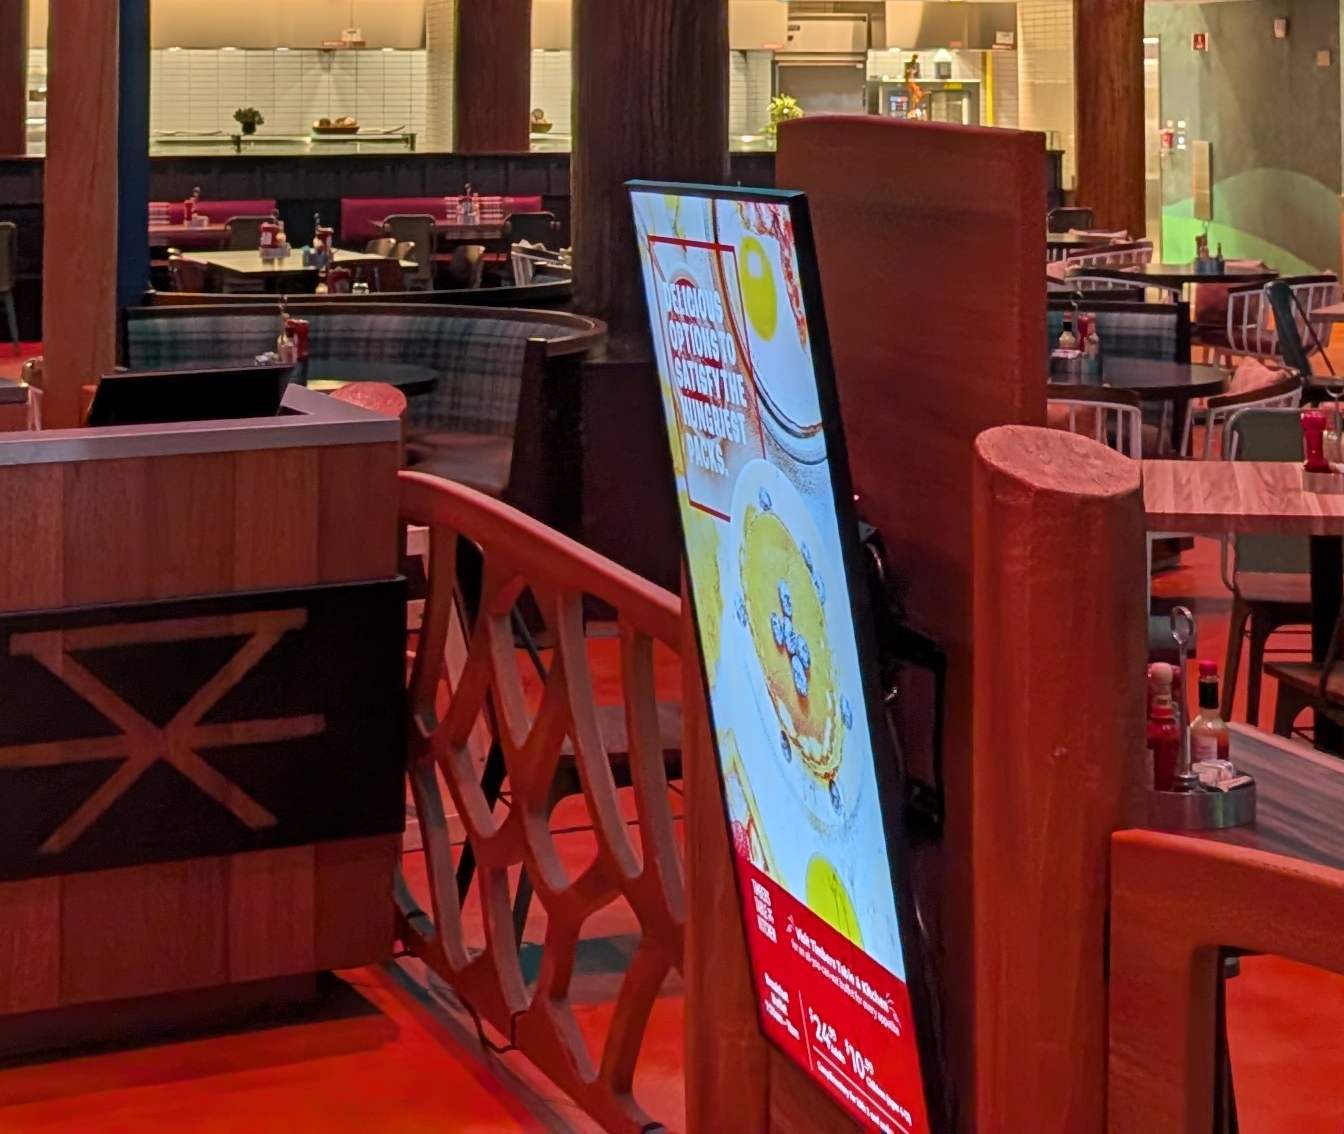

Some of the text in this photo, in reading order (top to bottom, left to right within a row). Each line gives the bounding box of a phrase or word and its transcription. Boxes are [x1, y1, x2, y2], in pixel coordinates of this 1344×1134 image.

[662, 282, 723, 324] DELICIOUS
[669, 320, 736, 366] OPTIONS TO
[674, 356, 747, 408] SATISFY THE
[680, 396, 747, 445] HUNGRIEST
[686, 432, 730, 477] PACKS.
